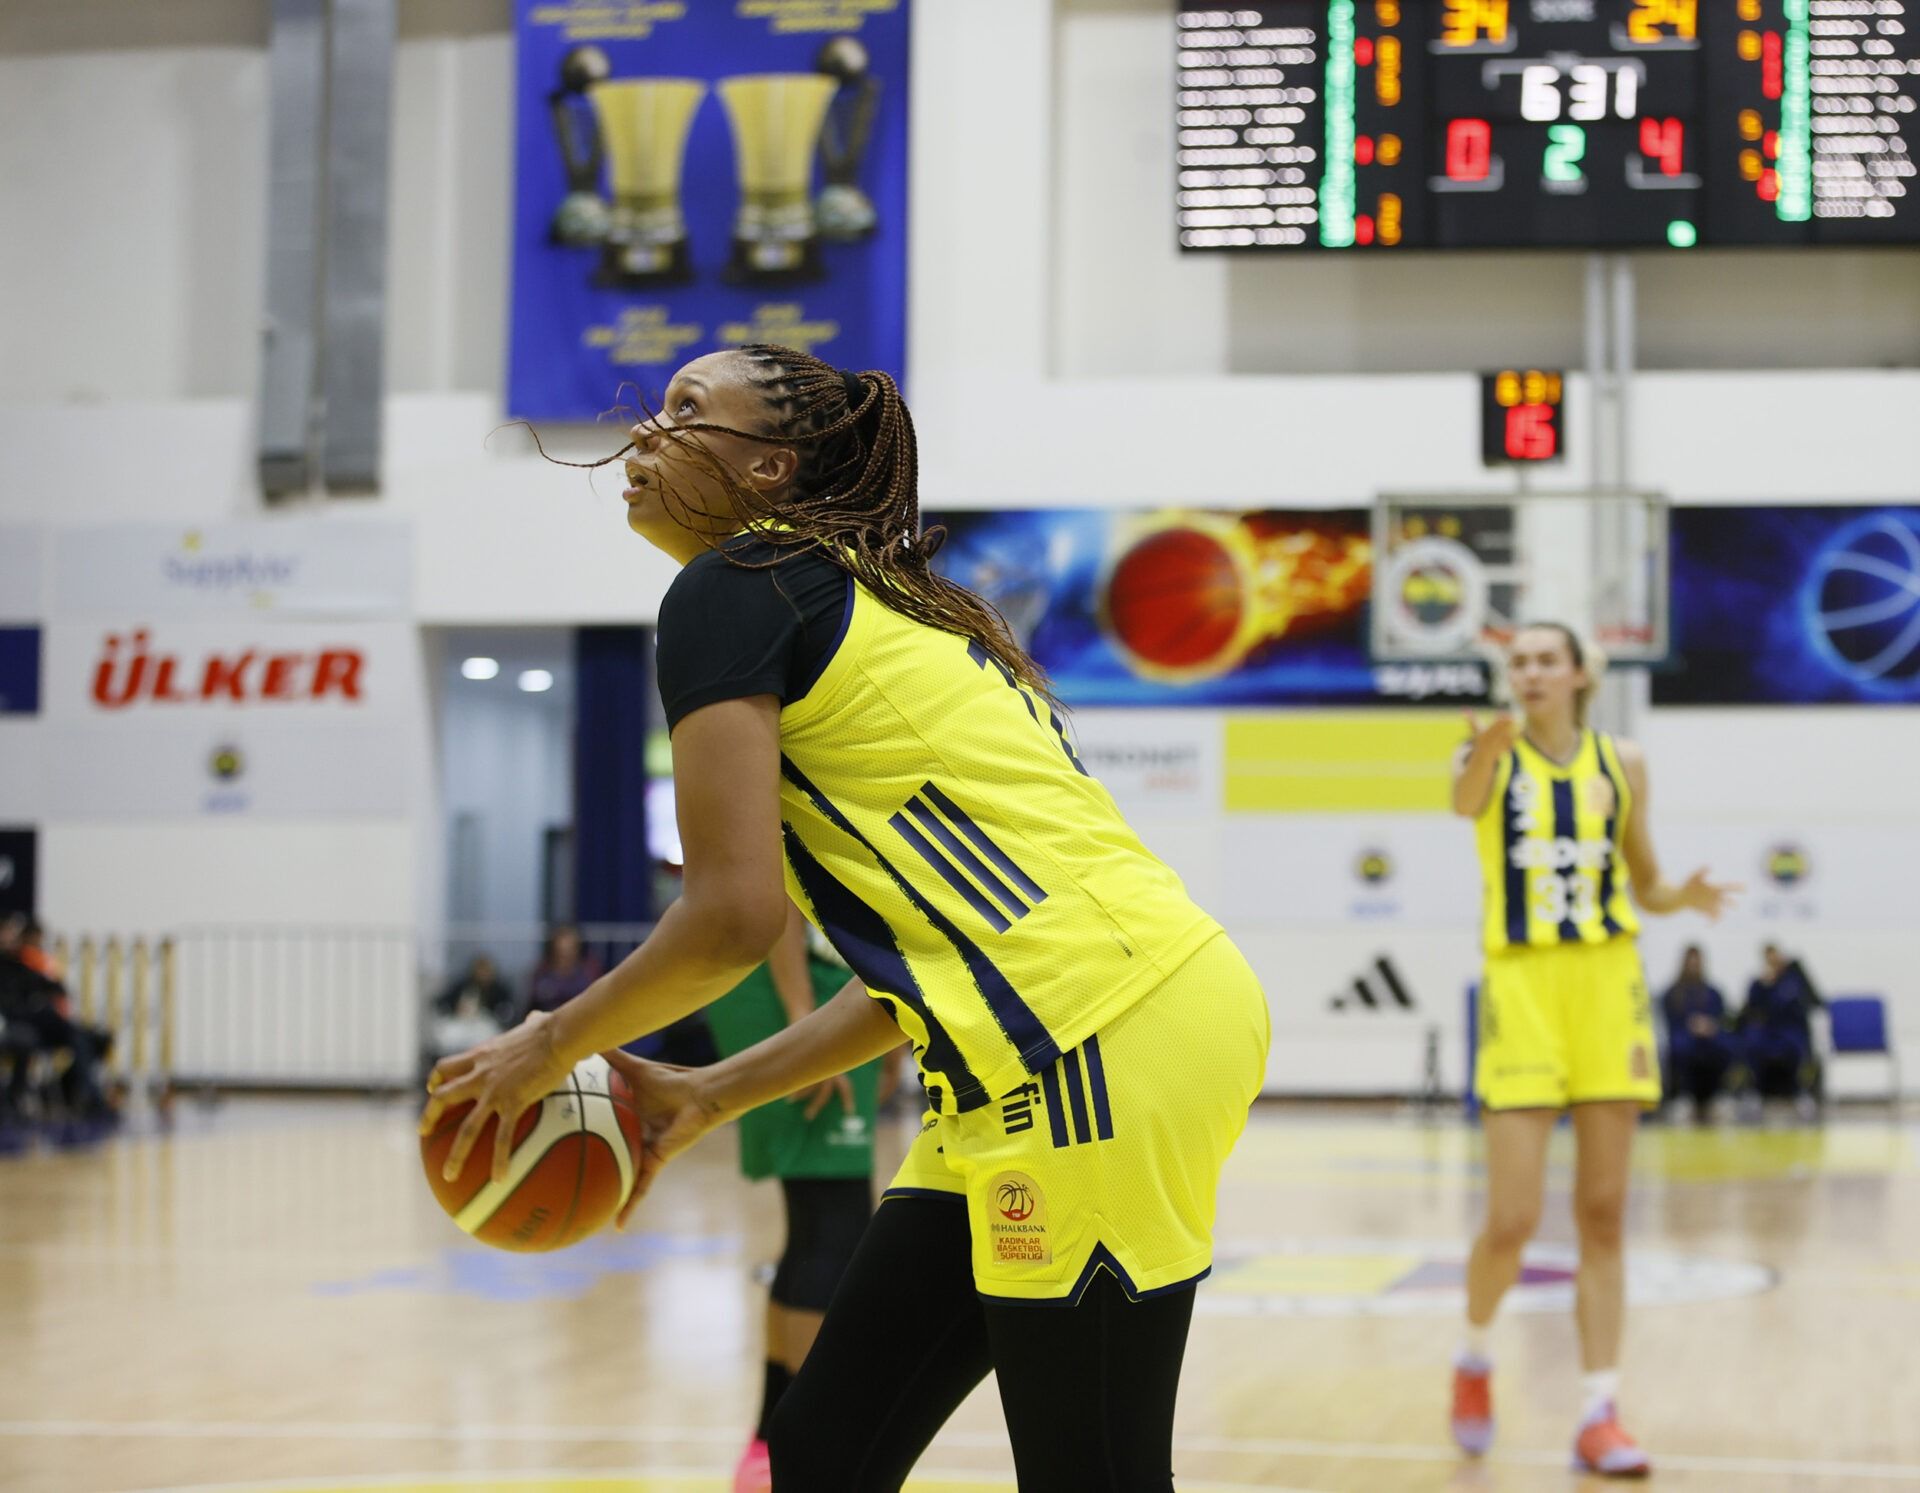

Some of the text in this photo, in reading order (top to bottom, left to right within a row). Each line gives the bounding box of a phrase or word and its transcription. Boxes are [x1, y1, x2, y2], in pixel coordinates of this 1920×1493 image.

[1446, 119, 1491, 181] 0
[1543, 124, 1586, 180] 2
[1639, 117, 1684, 177] 4
[92, 629, 366, 709] ÜLKER
[1535, 874, 1595, 923] 33
[997, 1244, 1045, 1252] BASKETBOL
[1001, 1224, 1046, 1233] HALKBANK
